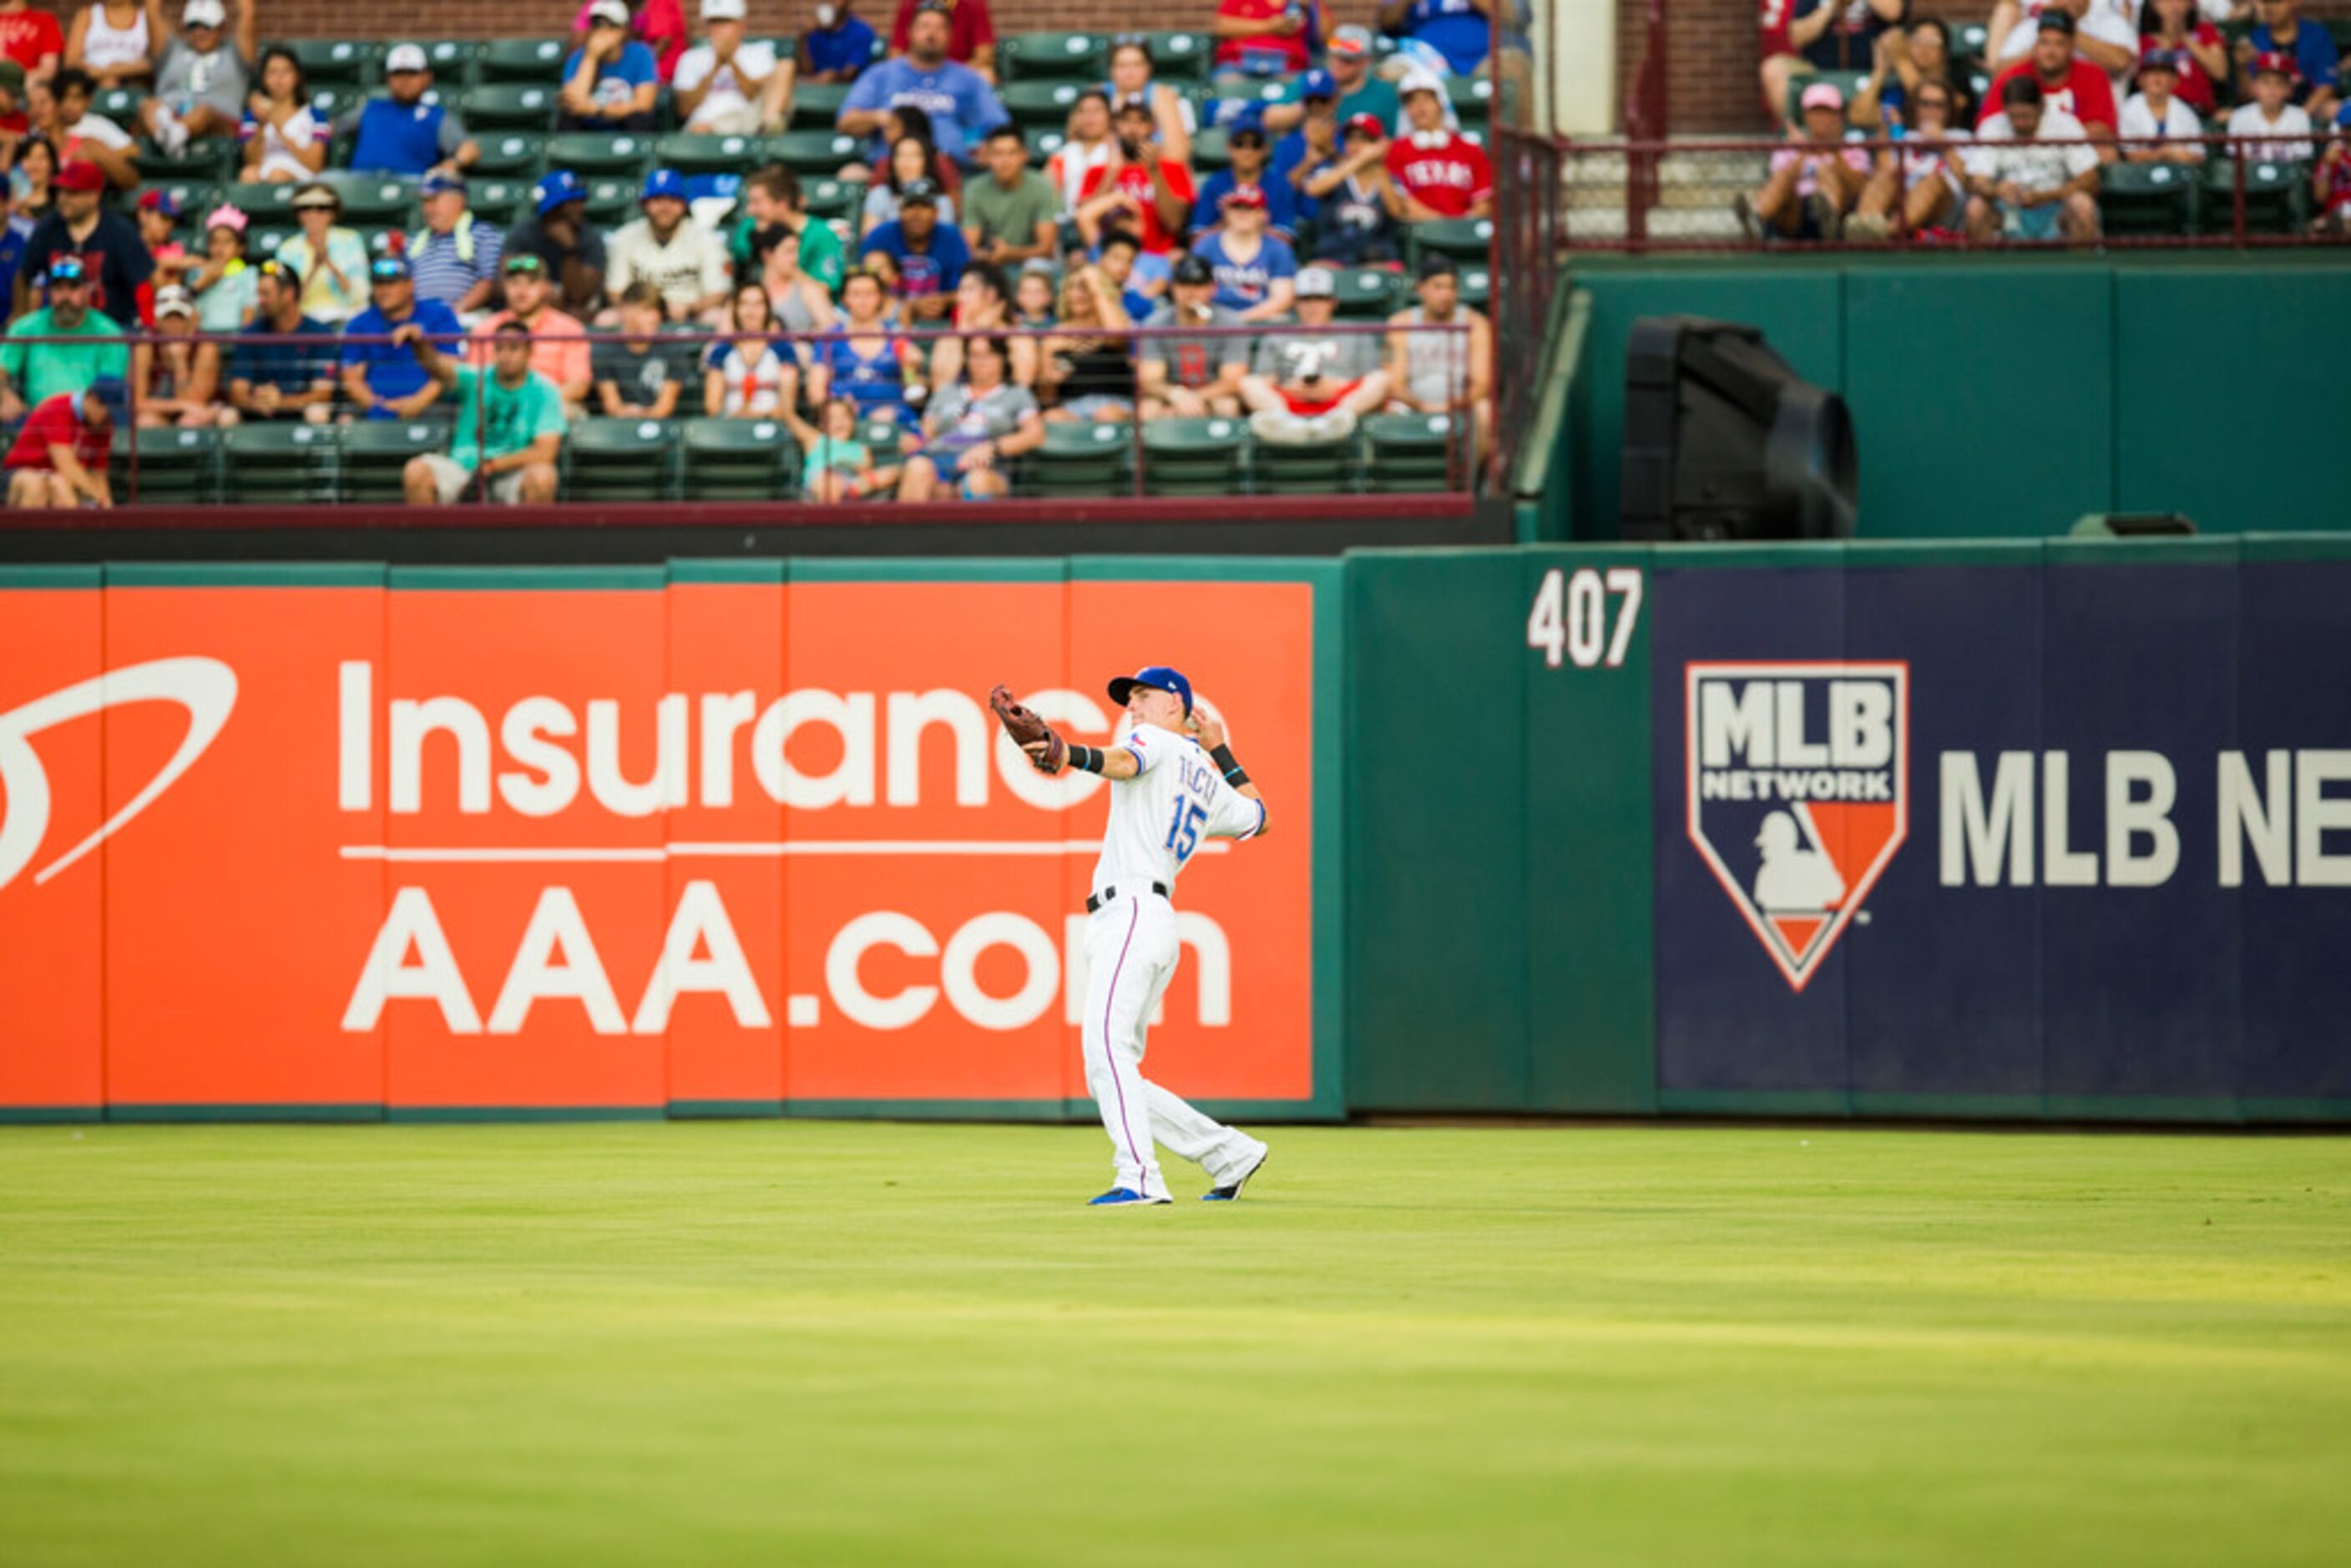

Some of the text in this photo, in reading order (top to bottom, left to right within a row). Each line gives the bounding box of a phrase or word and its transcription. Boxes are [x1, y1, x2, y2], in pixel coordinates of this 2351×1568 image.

[1528, 568, 1643, 667] 407
[1700, 680, 1893, 768] MLB
[1163, 793, 1207, 863] 15
[1700, 770, 1893, 802] NETWORK
[1939, 750, 2181, 887] MLB
